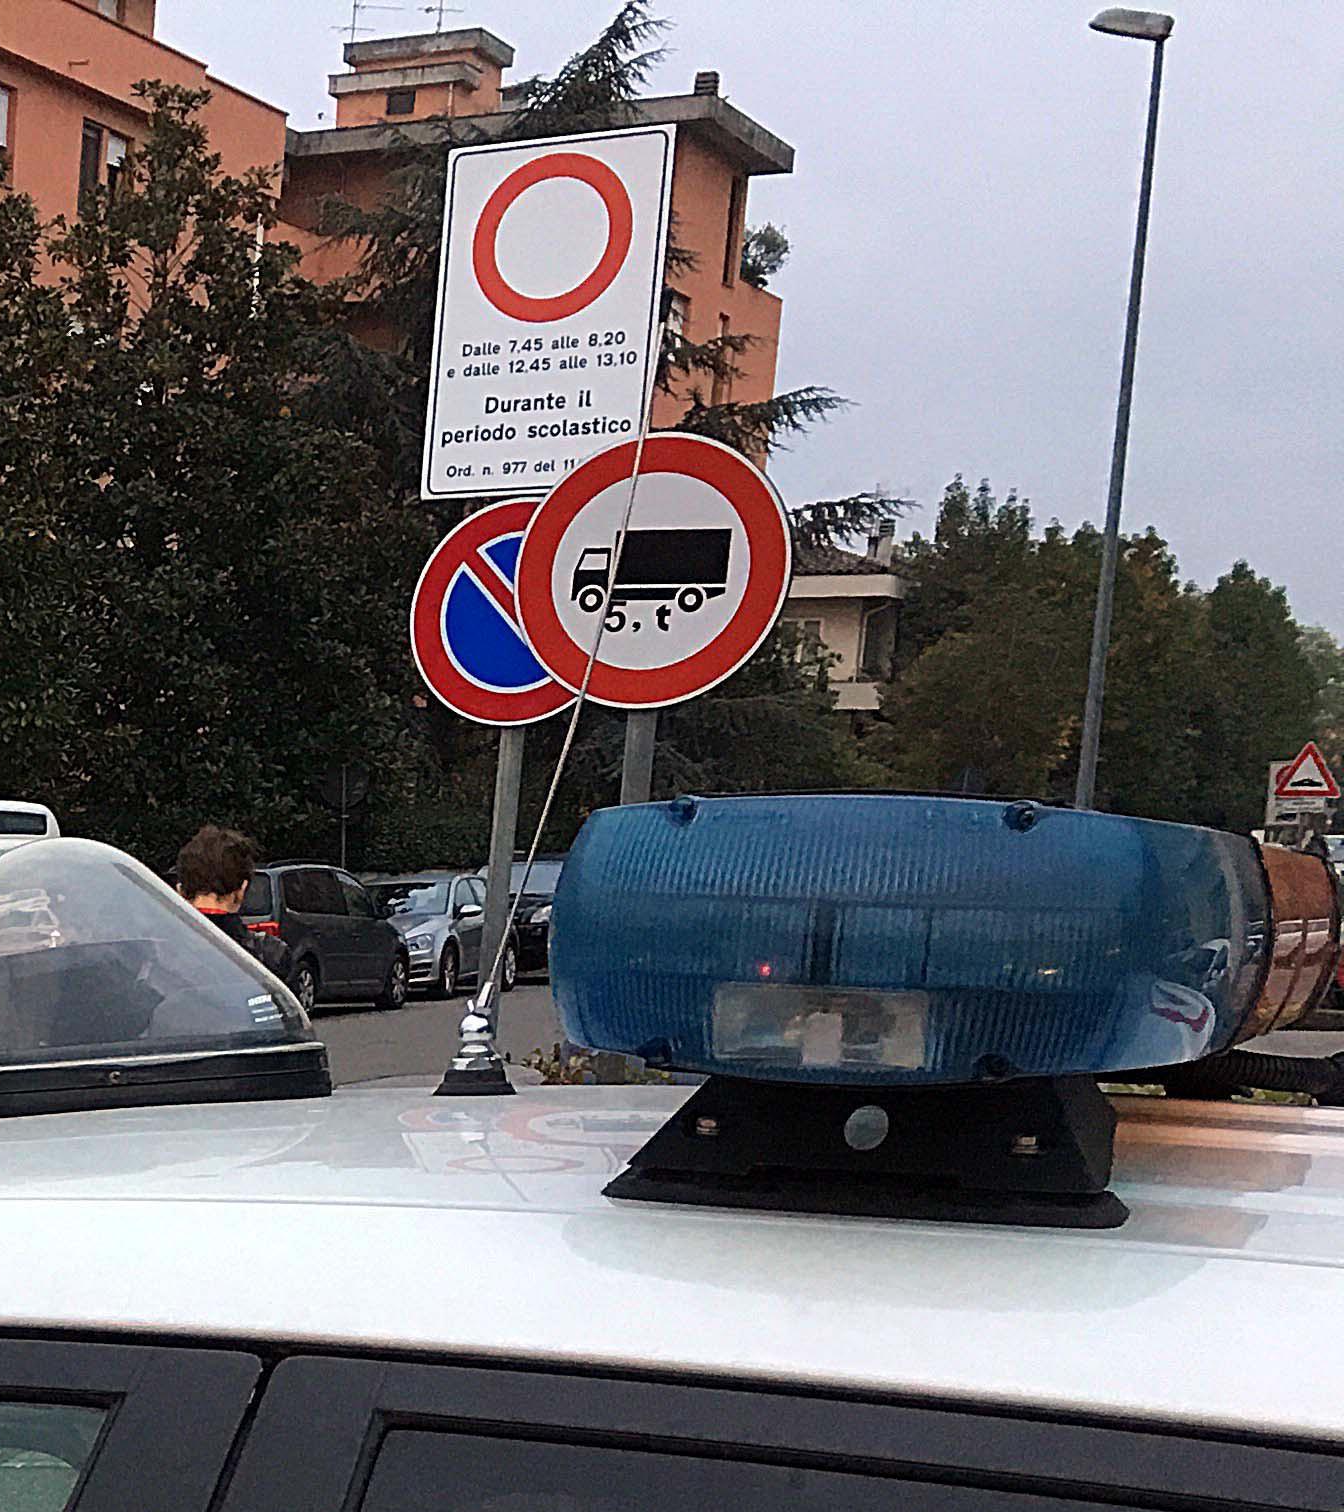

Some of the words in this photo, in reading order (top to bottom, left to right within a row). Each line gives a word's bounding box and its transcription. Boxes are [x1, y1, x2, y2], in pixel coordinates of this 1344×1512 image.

[462, 343, 501, 357] Dalle
[551, 336, 579, 350] alle
[446, 368, 456, 378] e
[463, 363, 500, 377] dalle
[559, 356, 588, 370] alle
[484, 392, 566, 414] Durante
[577, 390, 592, 408] il
[441, 423, 517, 447] periodo
[527, 416, 632, 438] scolastico
[446, 465, 475, 478] Ord.
[502, 461, 528, 474] 977
[534, 459, 555, 473] del
